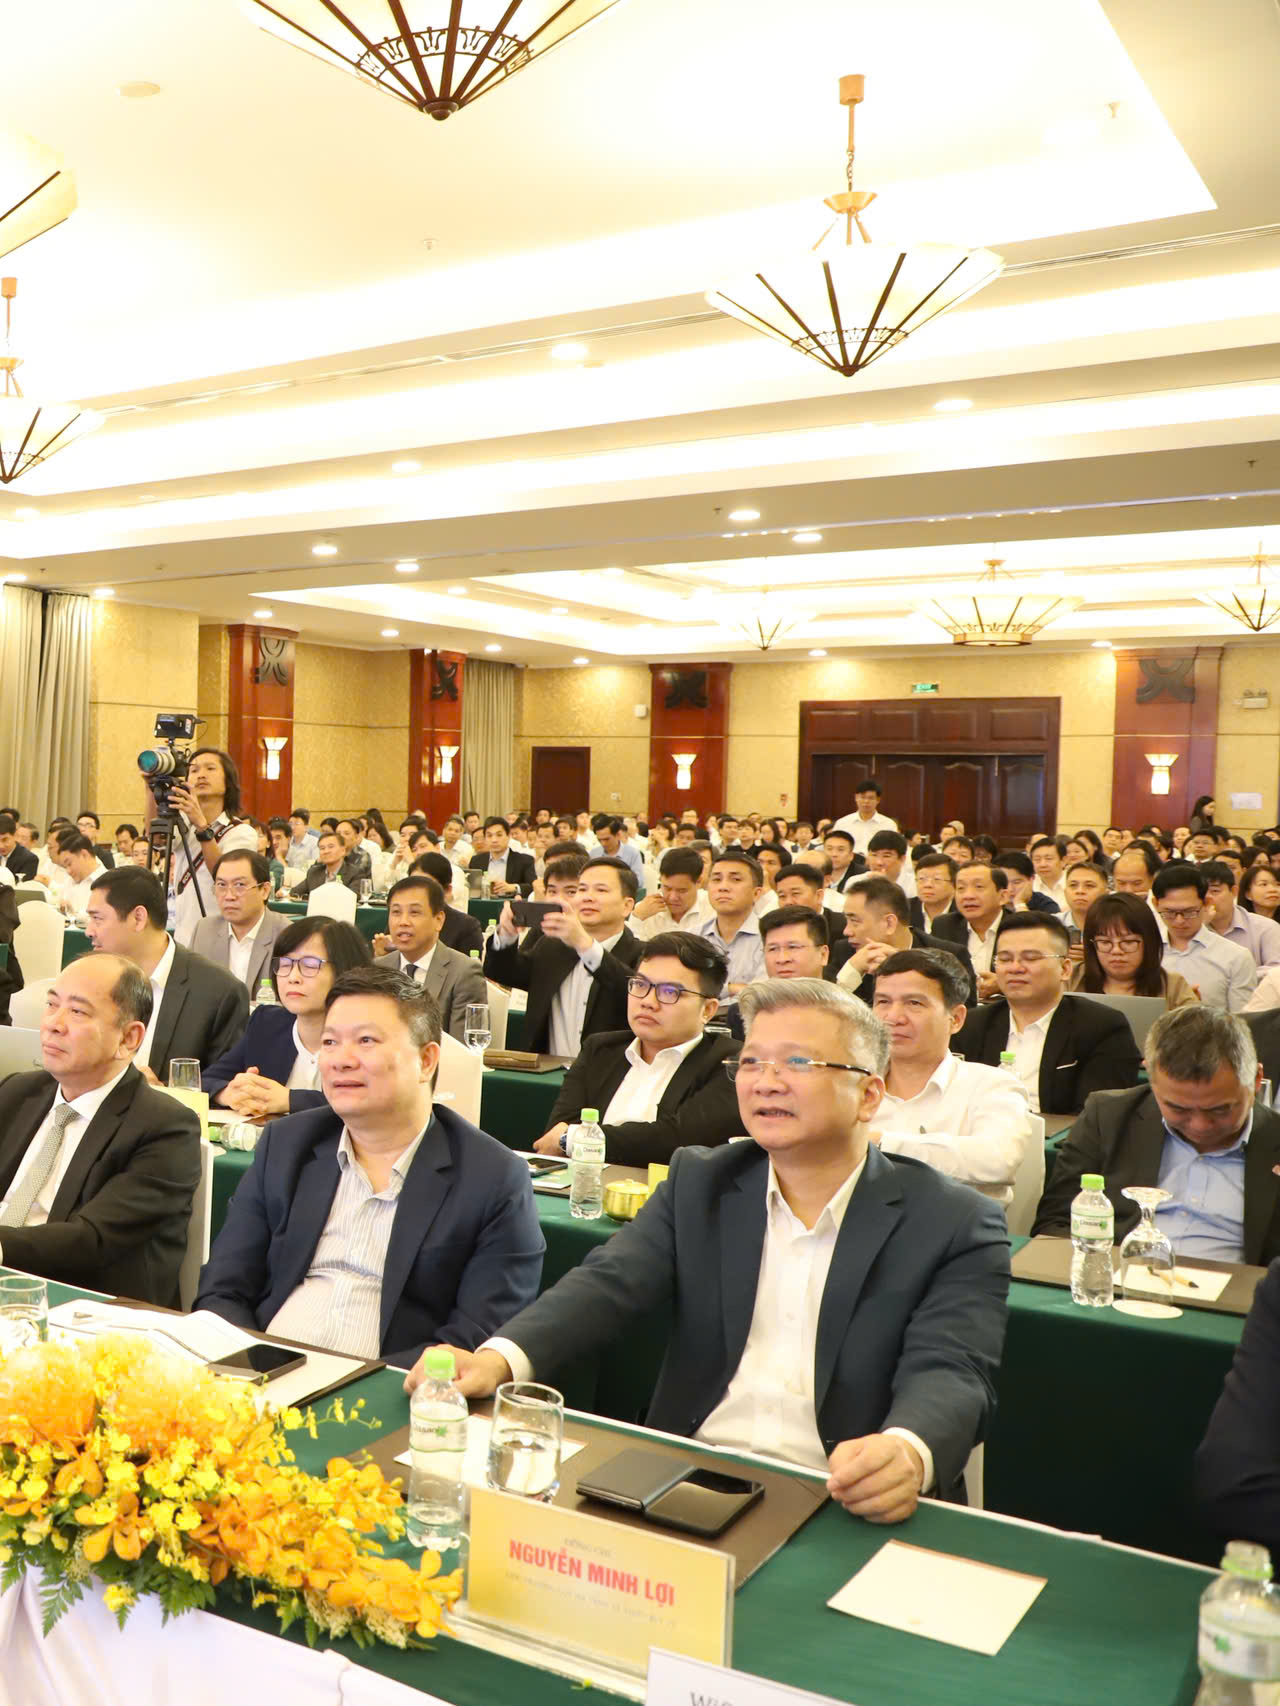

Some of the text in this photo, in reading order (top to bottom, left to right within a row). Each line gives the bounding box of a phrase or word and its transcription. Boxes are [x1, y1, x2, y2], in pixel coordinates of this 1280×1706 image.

[509, 1538, 582, 1579] NGUYỄN
[588, 1562, 638, 1595] MINH
[645, 1576, 676, 1608] LỢI
